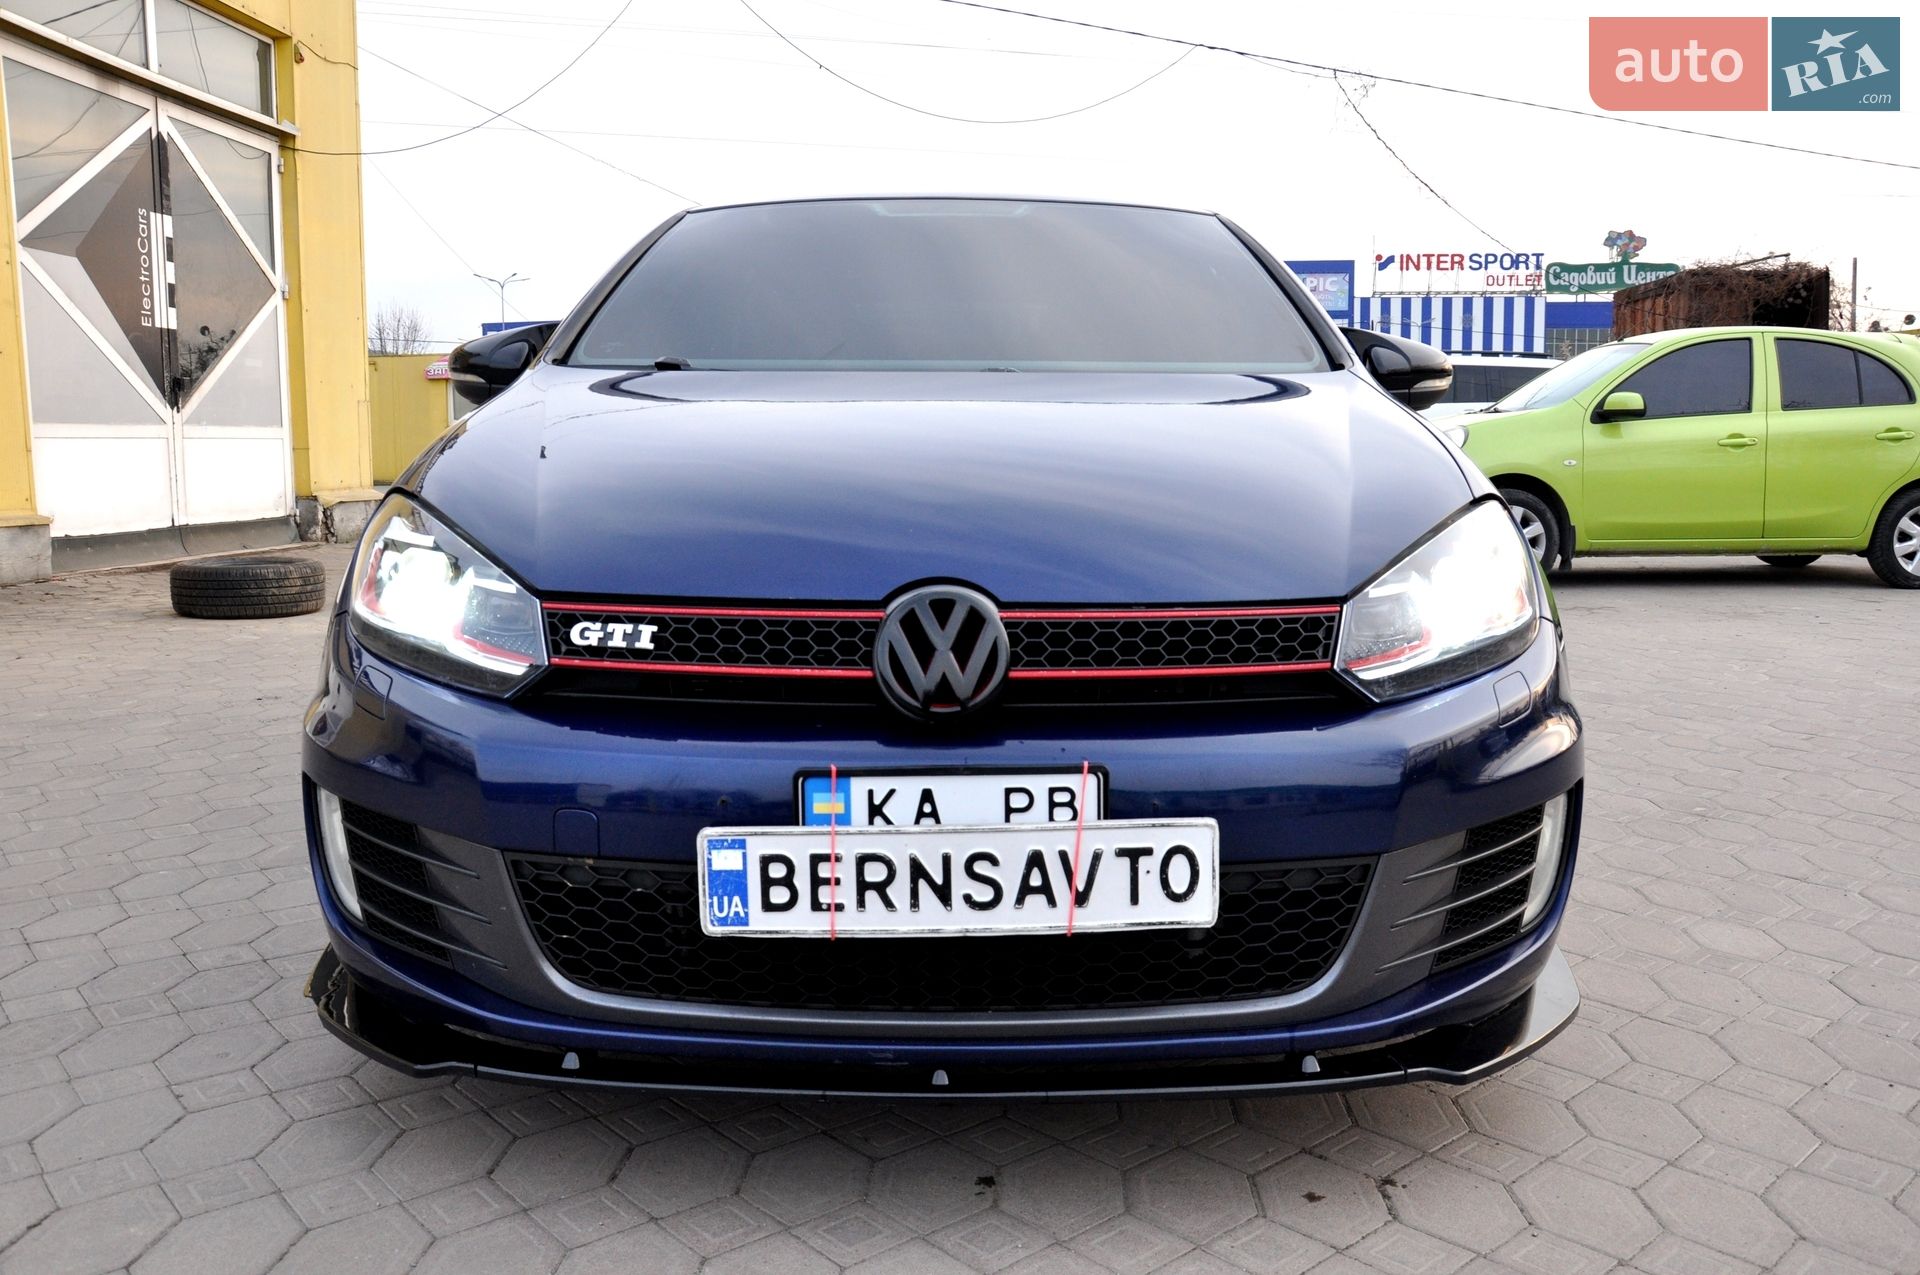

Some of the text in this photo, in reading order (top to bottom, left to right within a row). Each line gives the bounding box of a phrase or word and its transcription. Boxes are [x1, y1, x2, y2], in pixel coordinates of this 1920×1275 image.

[138, 208, 152, 327] ElectroCars
[1486, 275, 1543, 287] OUTLET
[1549, 265, 1616, 292] Садовий
[569, 621, 658, 650] GTI
[713, 844, 1201, 917] UA BERNSAVTO
